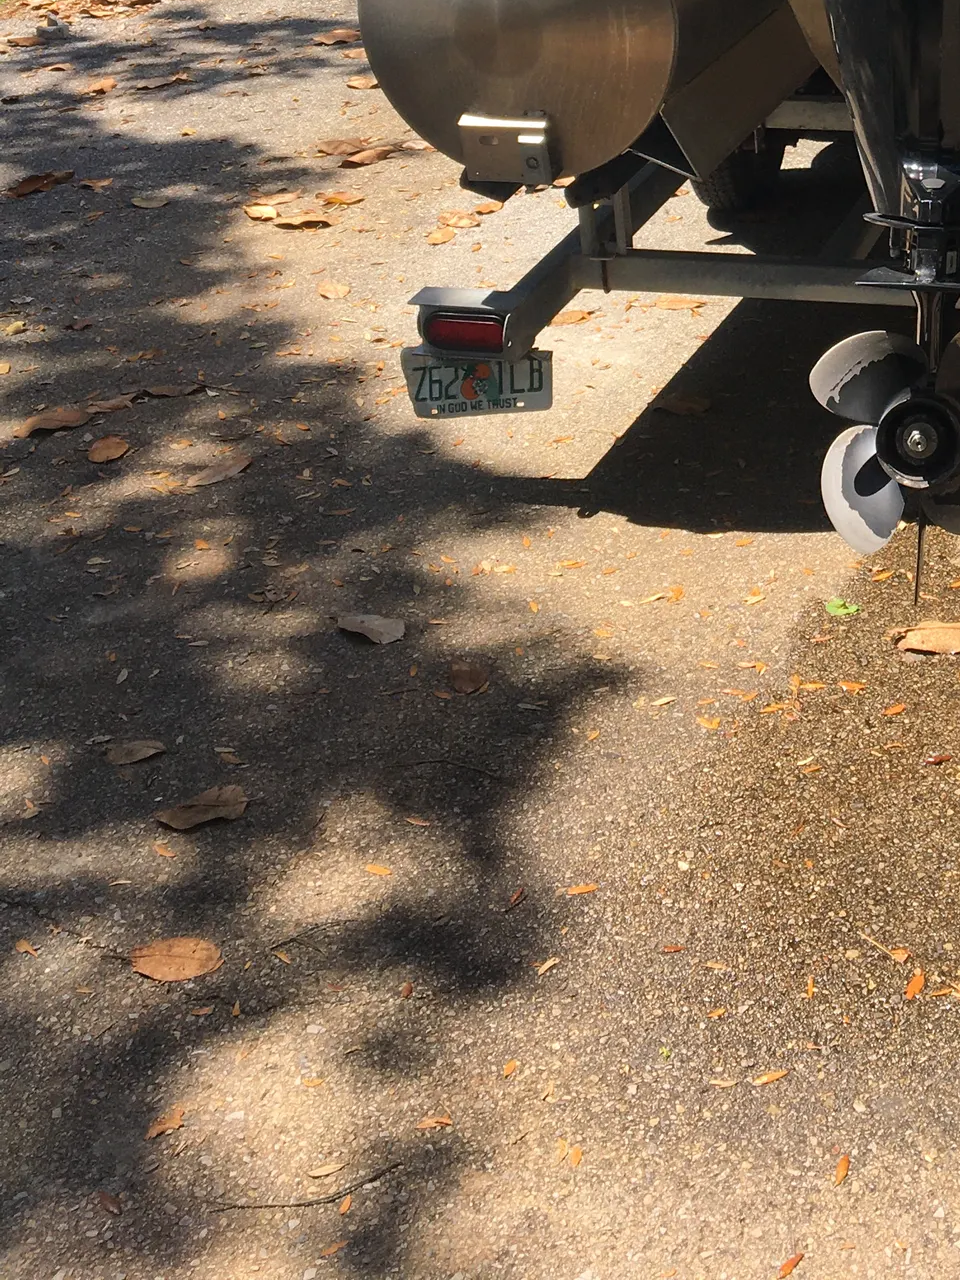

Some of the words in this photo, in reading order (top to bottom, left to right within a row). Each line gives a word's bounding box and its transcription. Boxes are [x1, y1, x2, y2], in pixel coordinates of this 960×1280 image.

[436, 403, 446, 414] IN
[447, 401, 467, 413] GOD
[470, 399, 484, 412] WE
